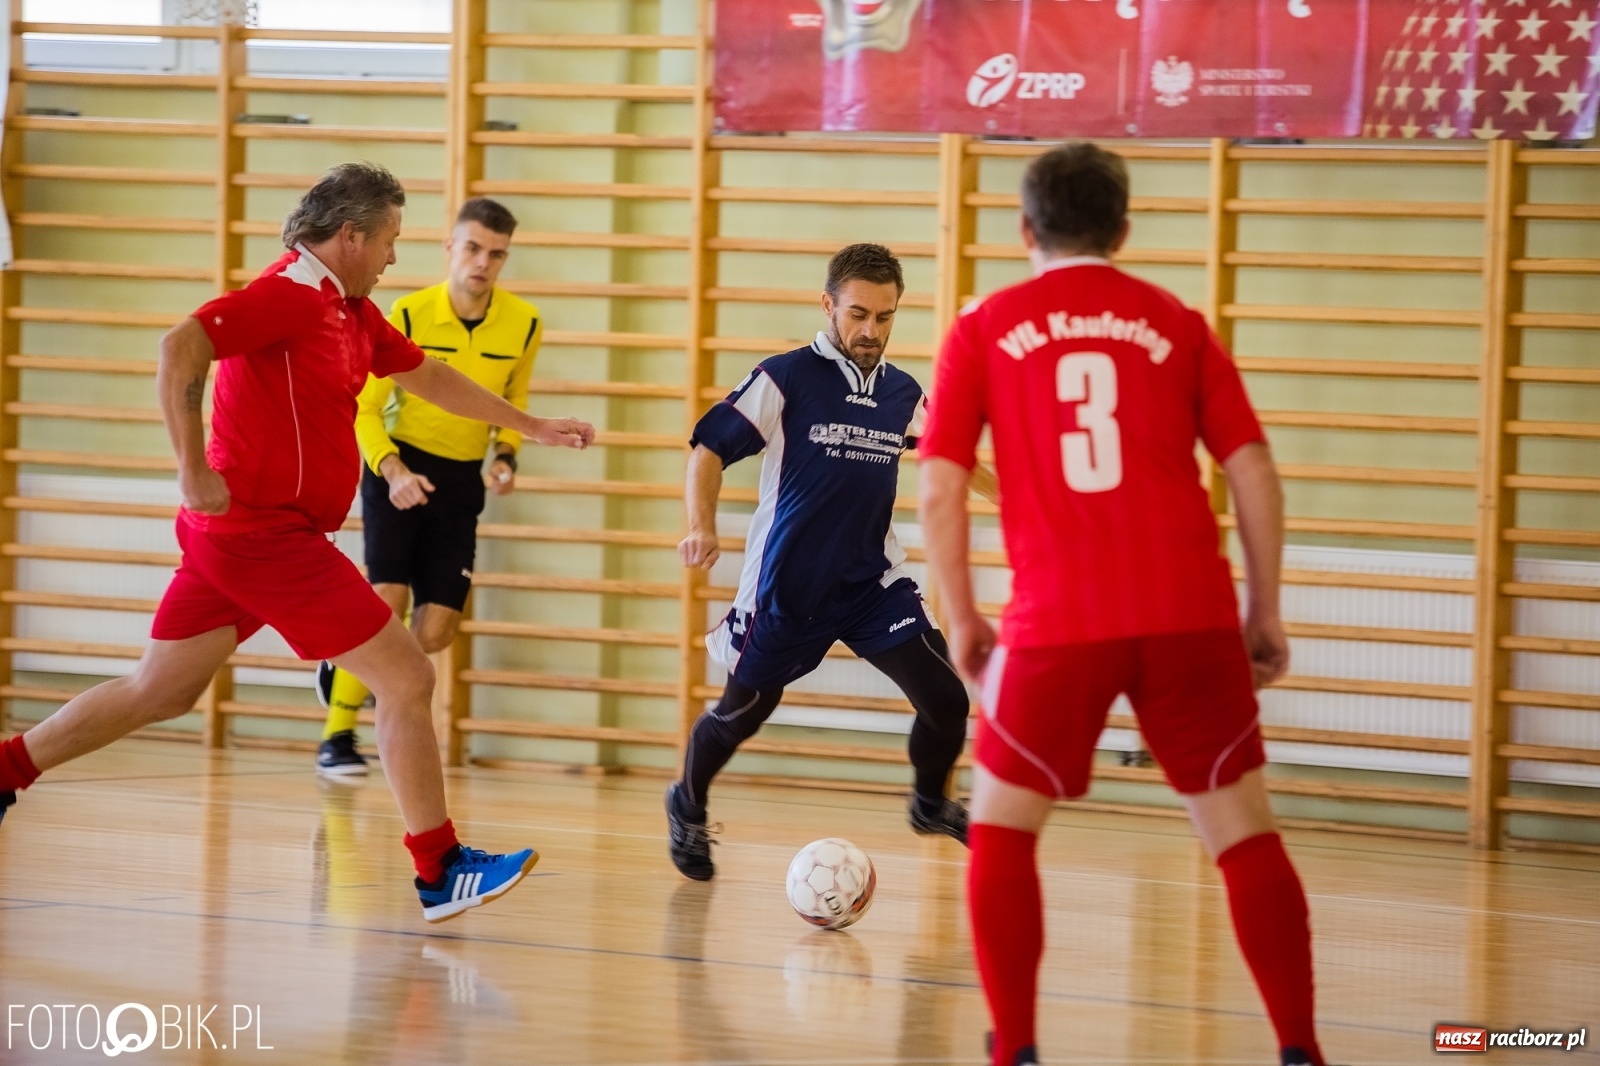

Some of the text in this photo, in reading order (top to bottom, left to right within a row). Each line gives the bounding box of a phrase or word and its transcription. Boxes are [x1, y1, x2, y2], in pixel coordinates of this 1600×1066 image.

[1017, 72, 1085, 99] ZPRP
[1047, 310, 1173, 364] Kaufering
[828, 423, 866, 437] PETER
[1056, 351, 1122, 493] 3
[825, 447, 842, 458] Tel.
